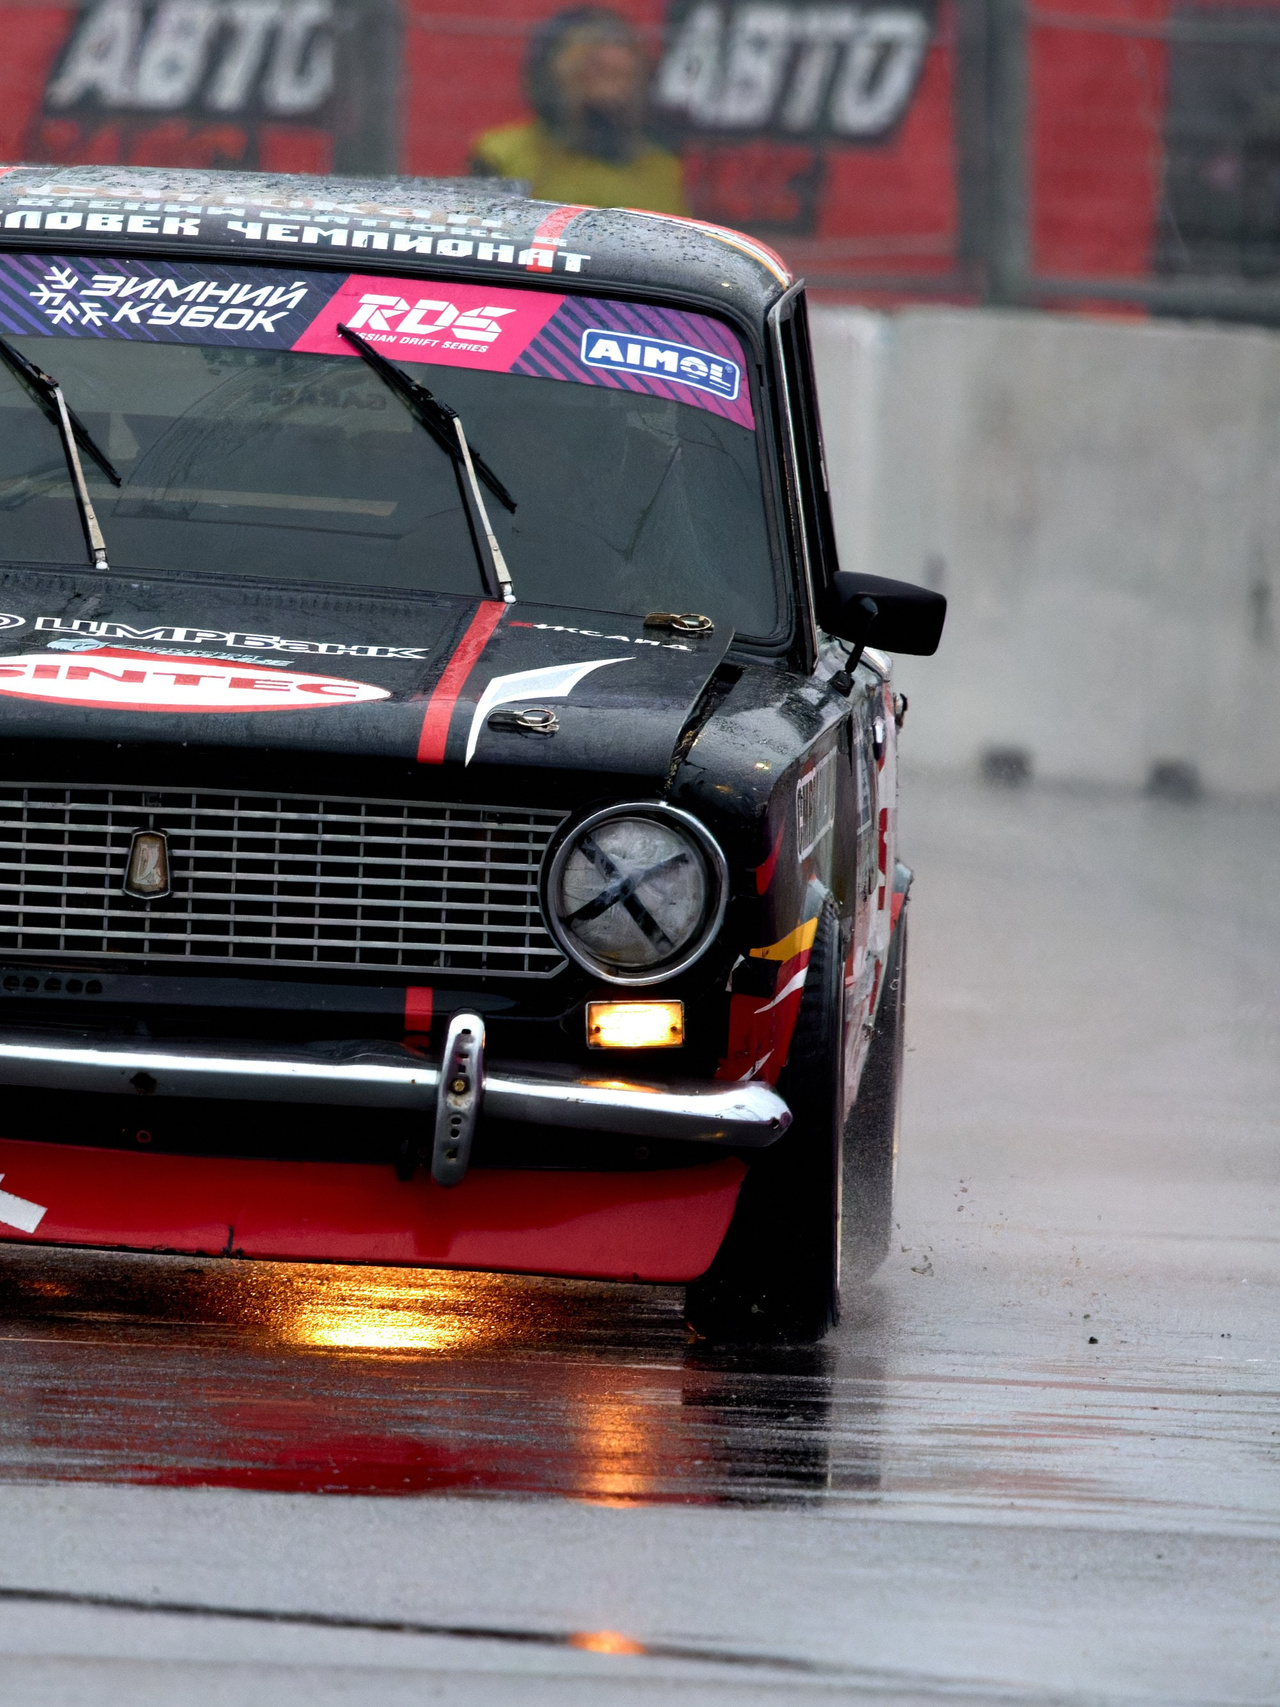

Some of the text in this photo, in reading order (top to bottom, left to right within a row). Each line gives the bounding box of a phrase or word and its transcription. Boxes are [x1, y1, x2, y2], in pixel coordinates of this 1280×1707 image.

[659, 3, 929, 135] АВТО
[226, 220, 591, 274] ЧЕМПИОНАТ
[80, 274, 308, 309] ЗИМНИЙ
[112, 301, 289, 333] КУБОК
[346, 293, 517, 343] RDS
[338, 332, 489, 353] SSIAN DRIFT SERIES
[587, 338, 732, 392] AIMOL
